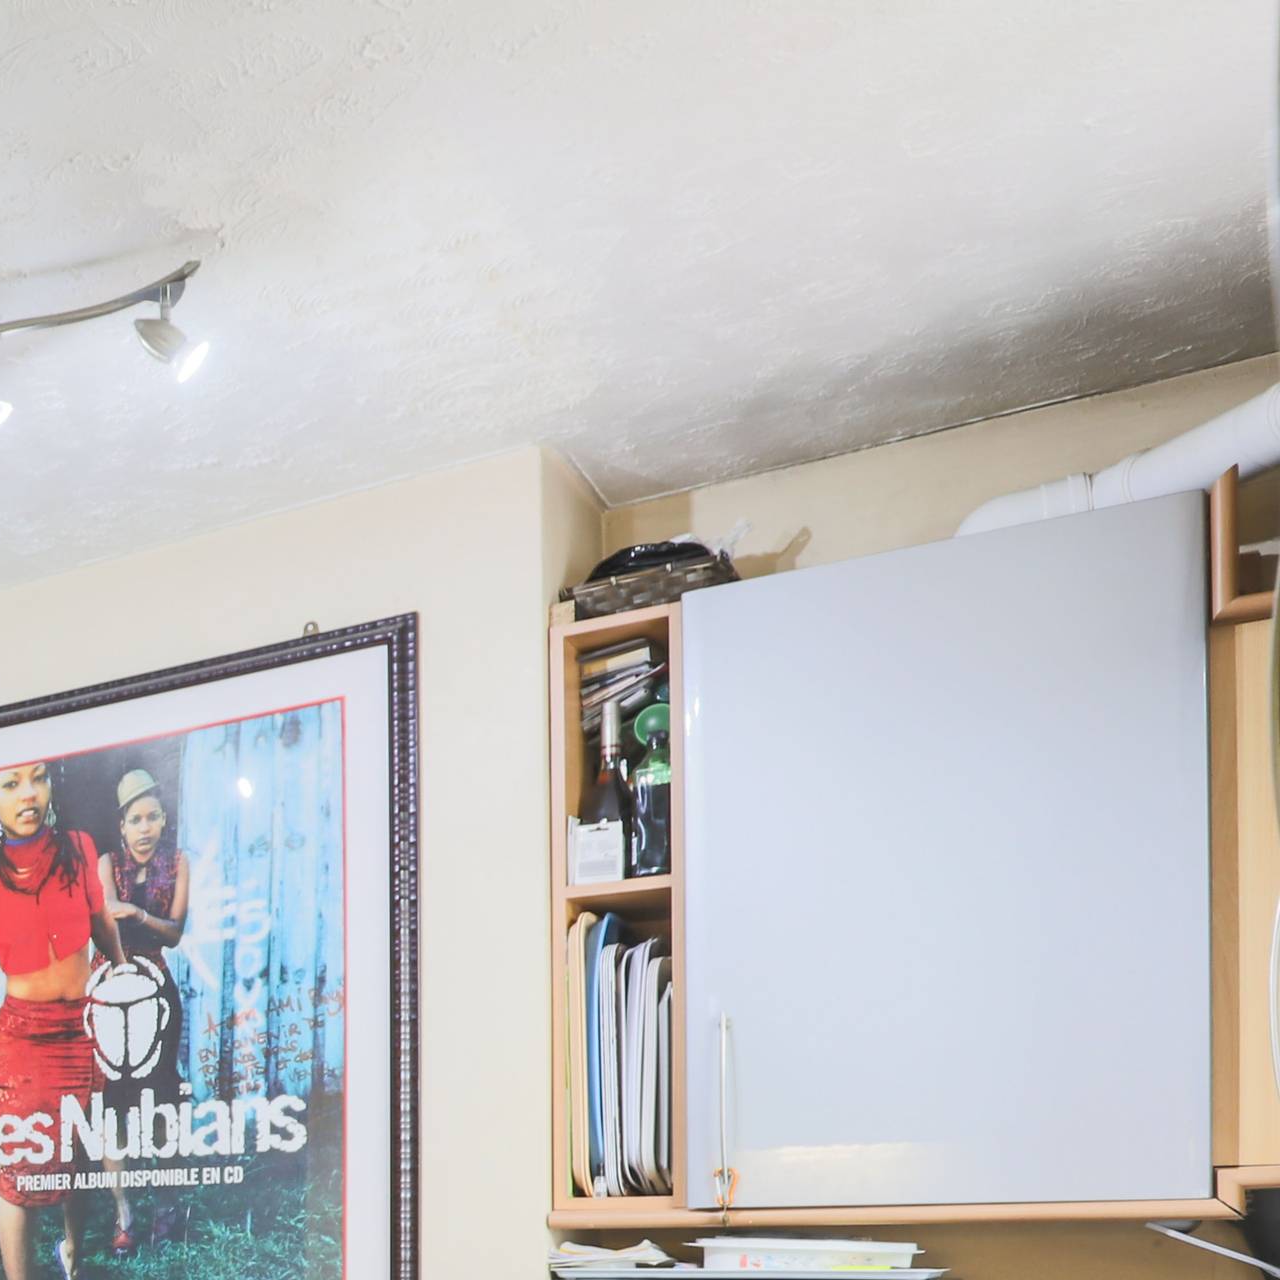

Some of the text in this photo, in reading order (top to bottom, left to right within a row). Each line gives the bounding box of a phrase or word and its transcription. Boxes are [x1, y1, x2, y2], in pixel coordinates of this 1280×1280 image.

[59, 1083, 308, 1164] Nubians
[16, 1165, 244, 1192] PREMIER ALBUM DISPONIBLE EN CD
